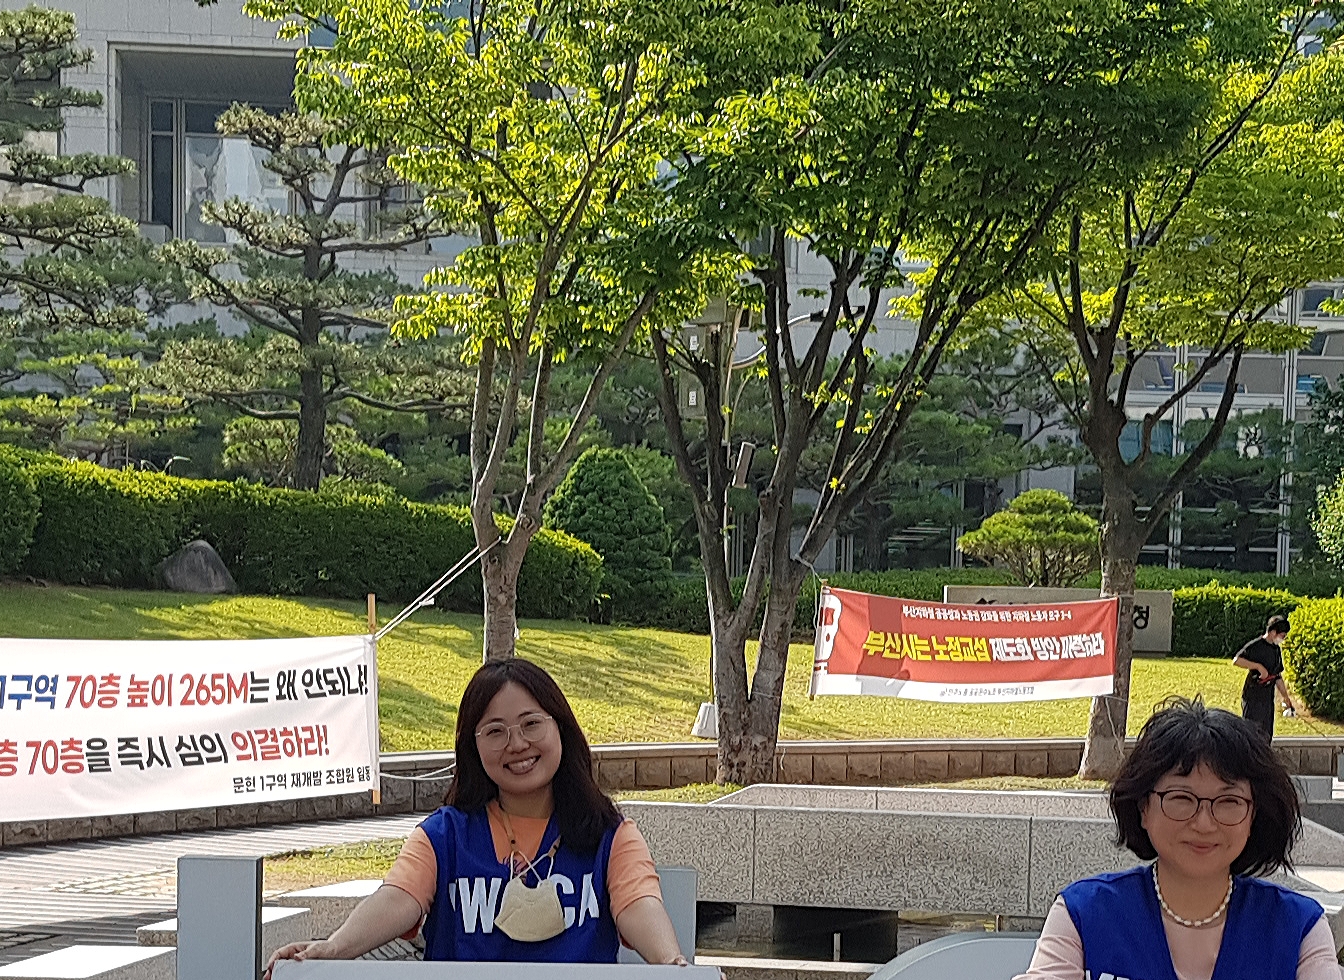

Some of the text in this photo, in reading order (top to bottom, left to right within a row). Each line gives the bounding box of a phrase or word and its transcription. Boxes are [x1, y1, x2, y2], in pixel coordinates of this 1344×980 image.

[862, 631, 1105, 662] 부산시는 노정교섭 제도화 방안 마련하라
[64, 673, 122, 710] 70층
[126, 673, 174, 708] 높이
[179, 671, 270, 706] 265M는
[275, 669, 298, 702] 왜
[301, 664, 369, 700] 안되냐!
[25, 736, 113, 776] 70층을
[117, 734, 173, 771] 즉시
[175, 732, 229, 767] 심의
[230, 724, 330, 762] 의결하라!
[233, 776, 256, 794] 문현
[259, 773, 288, 792] 1구역
[290, 770, 323, 789] 재개발
[325, 767, 355, 785] 조합원
[449, 877, 503, 934] W
